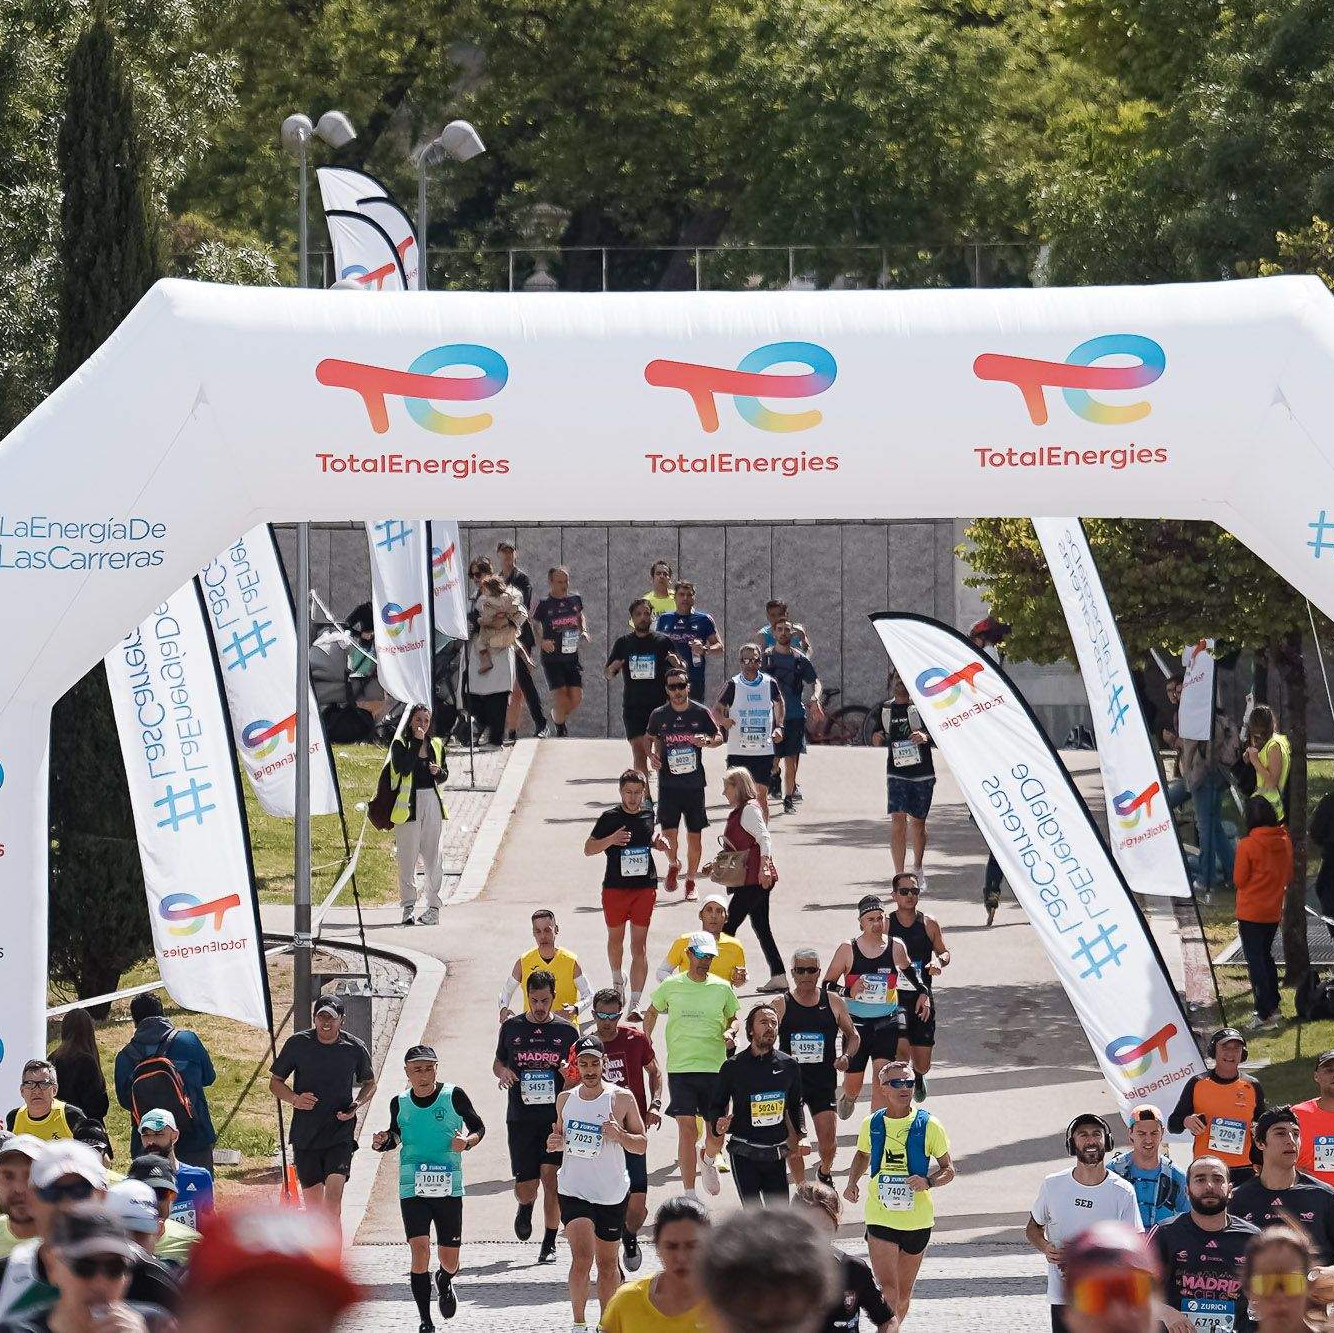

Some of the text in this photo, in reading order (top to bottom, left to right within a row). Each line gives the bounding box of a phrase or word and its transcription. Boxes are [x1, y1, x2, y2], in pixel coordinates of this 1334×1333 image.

[974, 443, 1168, 470] TotalEnergies
[315, 452, 510, 479] TotalEnergies
[645, 452, 840, 478] TotalEnergies
[798, 1043, 815, 1051] 4598
[517, 1052, 560, 1063] MADRID
[528, 1083, 546, 1092] 5452
[758, 1101, 779, 1111] 50261
[1224, 1120, 1243, 1128] ZURICH
[573, 1133, 593, 1144] 7023
[1219, 1129, 1236, 1140] 2706
[422, 1174, 445, 1183] 10118
[887, 1187, 906, 1196] 7402
[1074, 1198, 1094, 1209] SEB
[1182, 1275, 1243, 1294] MADRID
[1200, 1303, 1227, 1311] ZURICH
